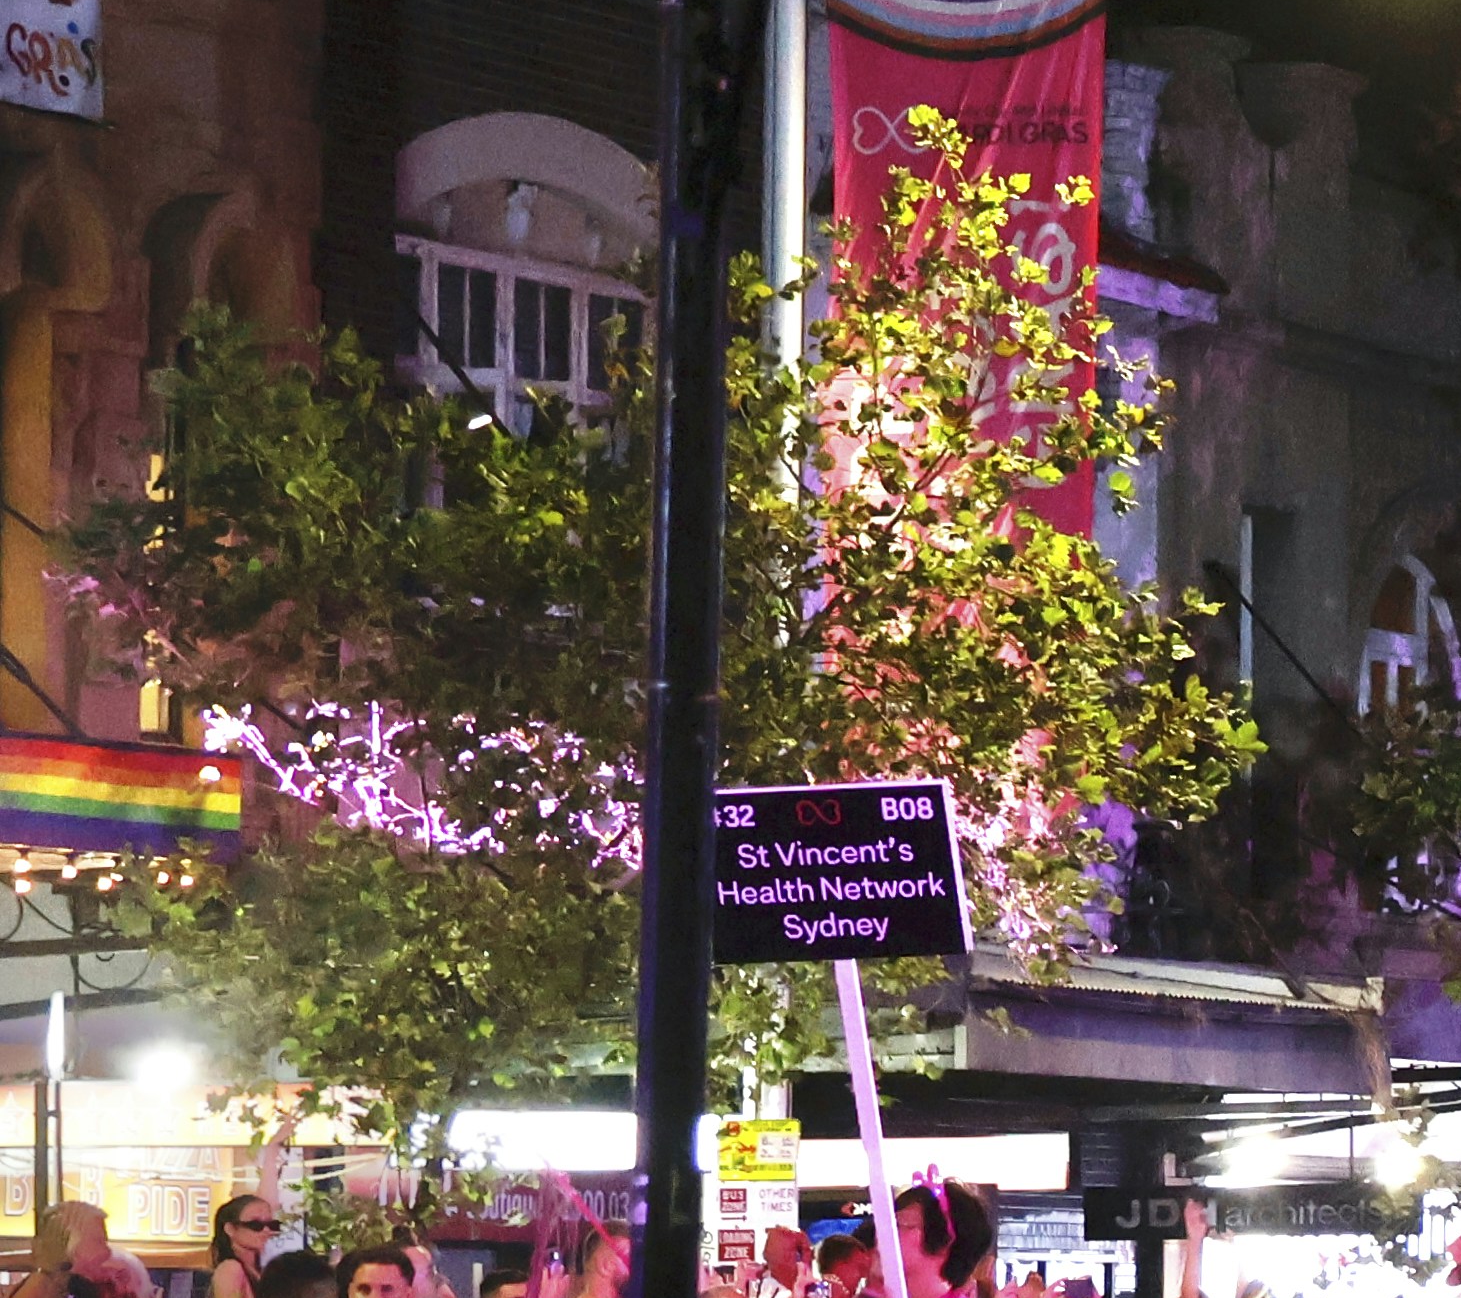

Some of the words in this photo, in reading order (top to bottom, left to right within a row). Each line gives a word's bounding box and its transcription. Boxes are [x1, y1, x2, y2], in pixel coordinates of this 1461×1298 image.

[880, 796, 934, 821] B08
[737, 843, 771, 868] St
[774, 836, 914, 867] Vincent's
[717, 877, 815, 906] Health
[819, 871, 946, 901] Network
[783, 911, 889, 945] Sydney
[127, 1183, 211, 1237] PIDE
